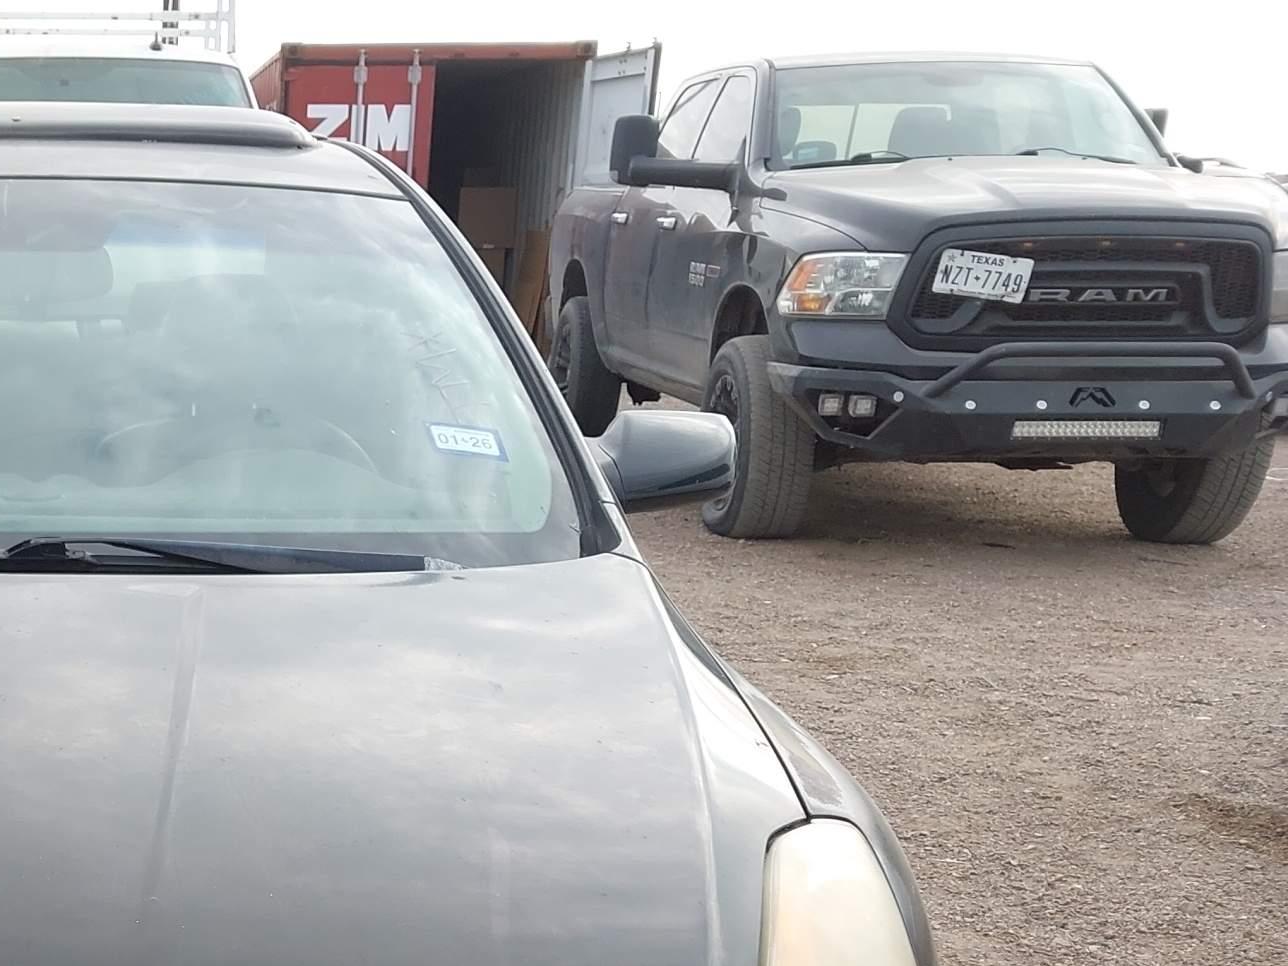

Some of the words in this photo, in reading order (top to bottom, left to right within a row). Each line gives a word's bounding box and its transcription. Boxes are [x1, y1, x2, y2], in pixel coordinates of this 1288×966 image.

[307, 104, 411, 151] ZIM
[971, 254, 1005, 267] TEXAS
[1028, 288, 1169, 303] RAM
